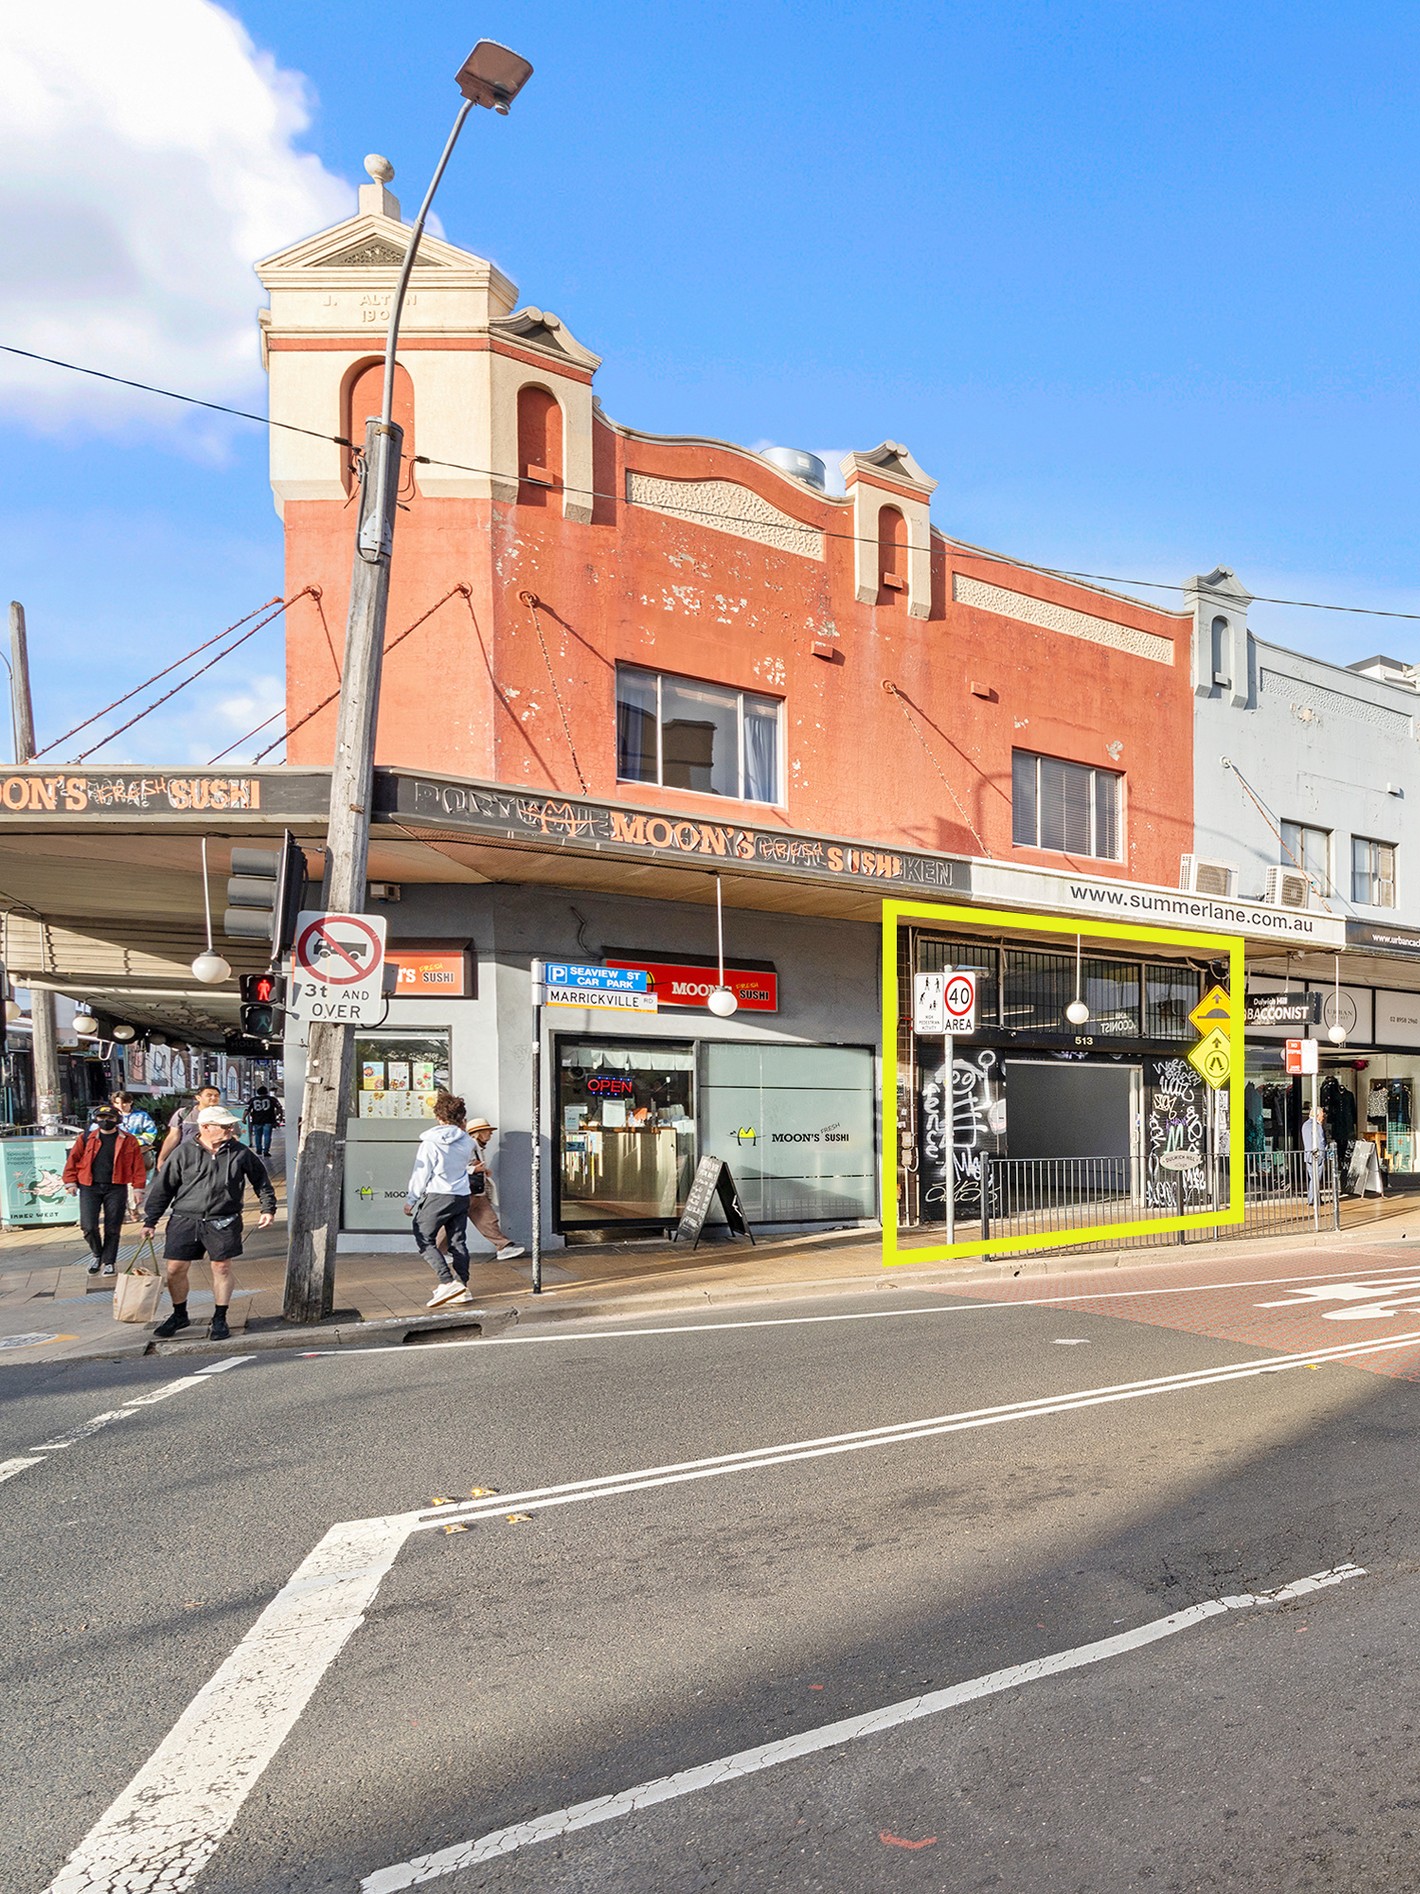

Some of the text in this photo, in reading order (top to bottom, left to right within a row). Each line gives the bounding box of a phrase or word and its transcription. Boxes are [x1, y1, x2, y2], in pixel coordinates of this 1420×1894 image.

[359, 294, 417, 306] ALTN
[0, 775, 89, 811] ON'S
[169, 779, 261, 810] SUSHI
[609, 811, 755, 860] MOON'S
[1071, 885, 1313, 934] www.summerlane.com.au
[423, 972, 454, 983] SUSHI
[570, 967, 641, 981] SEAVIEW ST
[577, 977, 633, 989] CAR PARK
[305, 984, 369, 1000] 3t AND
[550, 991, 640, 1007] MARRICKVILLE
[740, 989, 769, 1000] SUSHI
[949, 988, 970, 1005] 40
[312, 1003, 361, 1018] OVER
[945, 1019, 972, 1030] AREA
[1074, 1036, 1093, 1045] 513
[587, 1079, 633, 1093] OPEN
[820, 1122, 841, 1134] FRESH
[772, 1133, 849, 1142] MOON'S SUSHI
